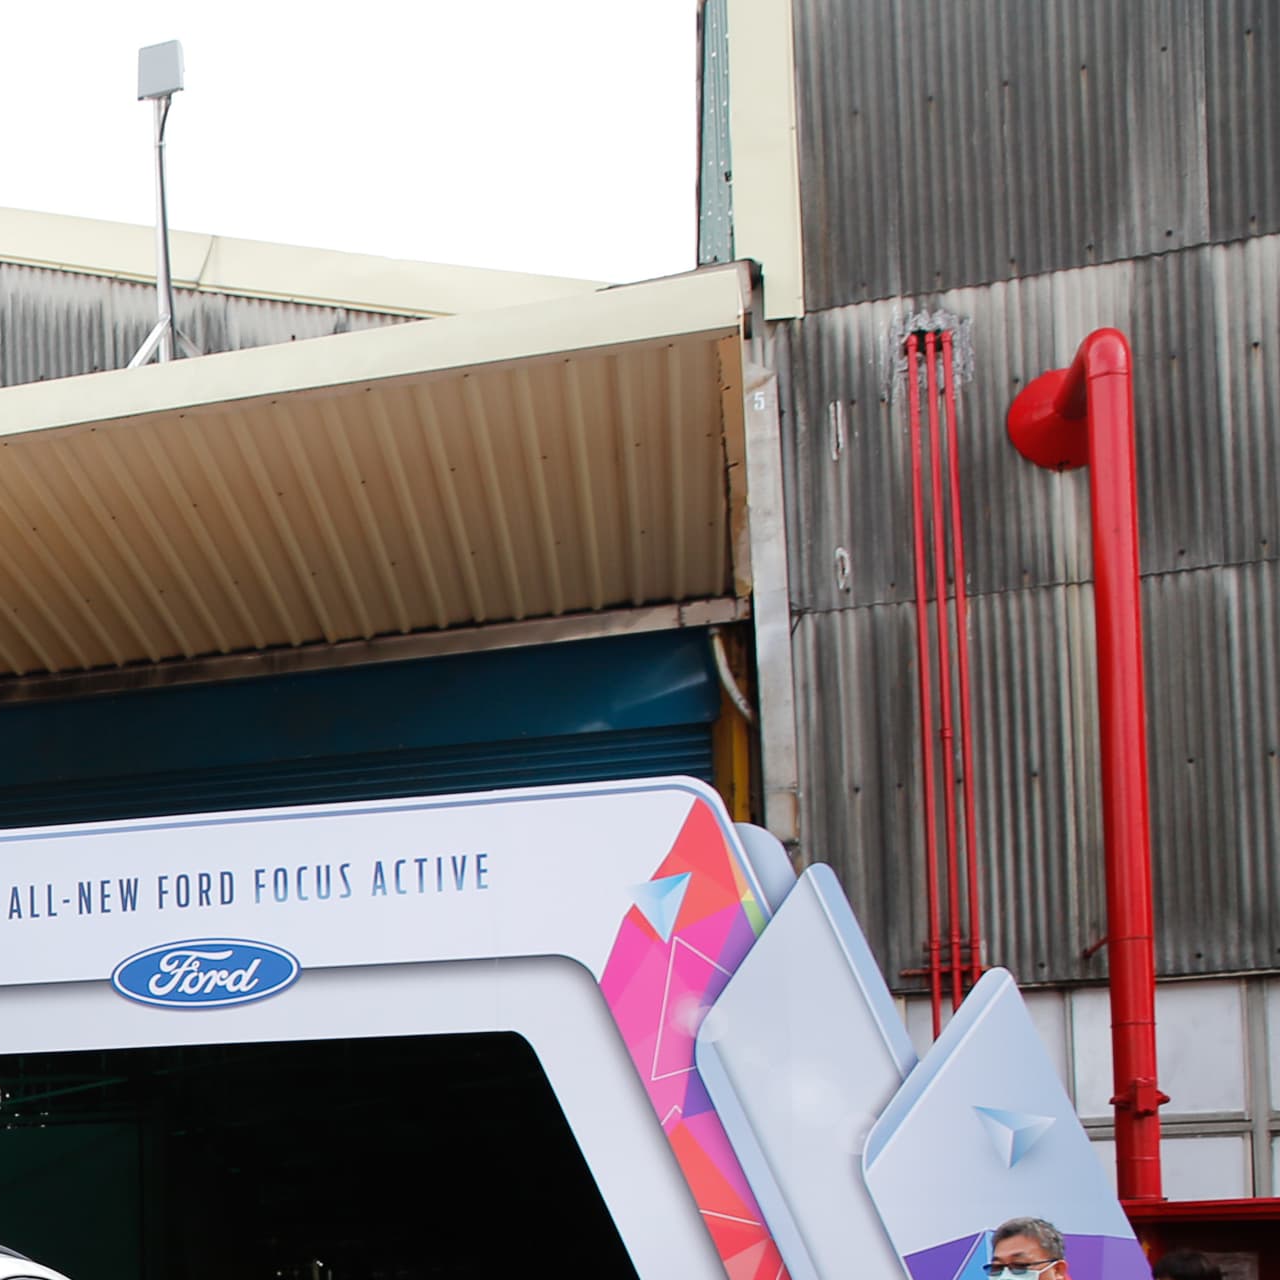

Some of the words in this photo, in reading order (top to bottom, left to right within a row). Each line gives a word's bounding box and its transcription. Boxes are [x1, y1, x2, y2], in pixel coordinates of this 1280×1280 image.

[754, 391, 765, 410] 5
[8, 877, 139, 920] ALL-NEW
[157, 871, 235, 910] FORD
[254, 862, 352, 904] FOCUS
[371, 853, 489, 897] ACTIVE
[147, 949, 263, 997] Ford
